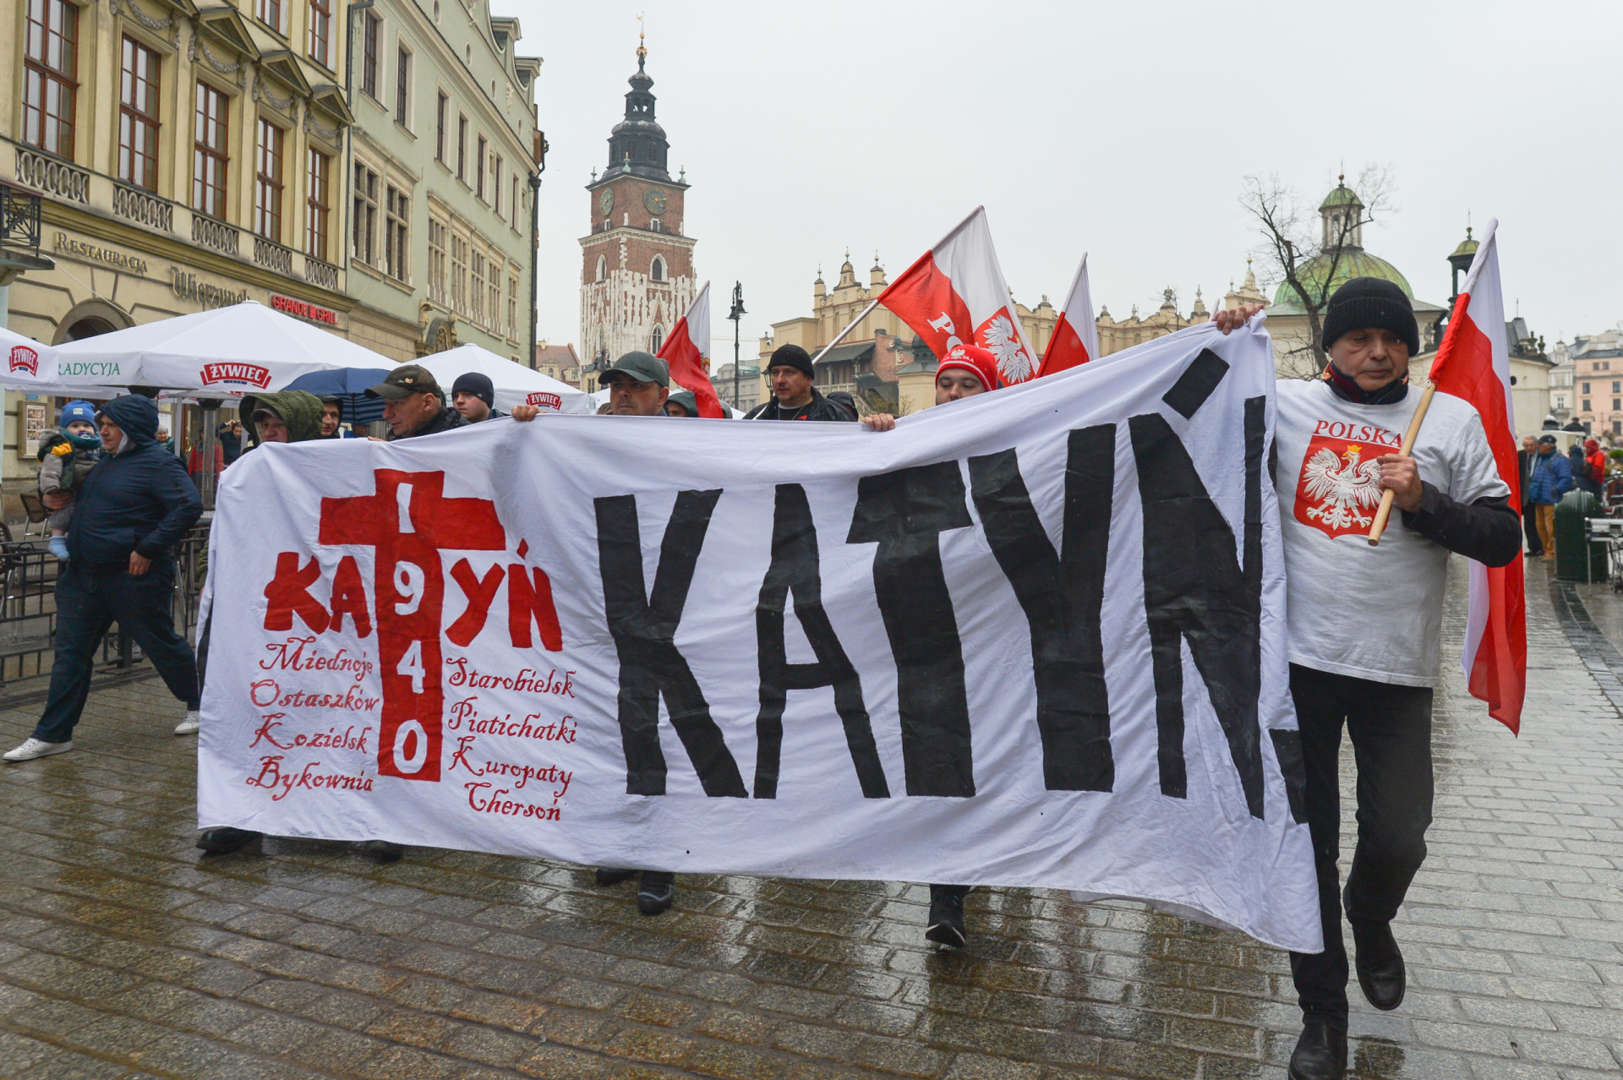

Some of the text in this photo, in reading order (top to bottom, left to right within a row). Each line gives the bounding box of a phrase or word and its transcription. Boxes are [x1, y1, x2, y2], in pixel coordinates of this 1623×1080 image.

[209, 363, 264, 381] ŻYWIEC
[1314, 419, 1403, 449] POLSKA
[593, 348, 1305, 824] KATYŃ
[259, 636, 373, 681] Miednoje
[446, 657, 576, 698] Starobielsk
[250, 679, 379, 711] Ostaszków
[249, 712, 372, 754] Kozielsk
[448, 696, 577, 744] Piatichatki
[246, 755, 374, 801] Bykownia
[448, 736, 573, 798] Kuropaty
